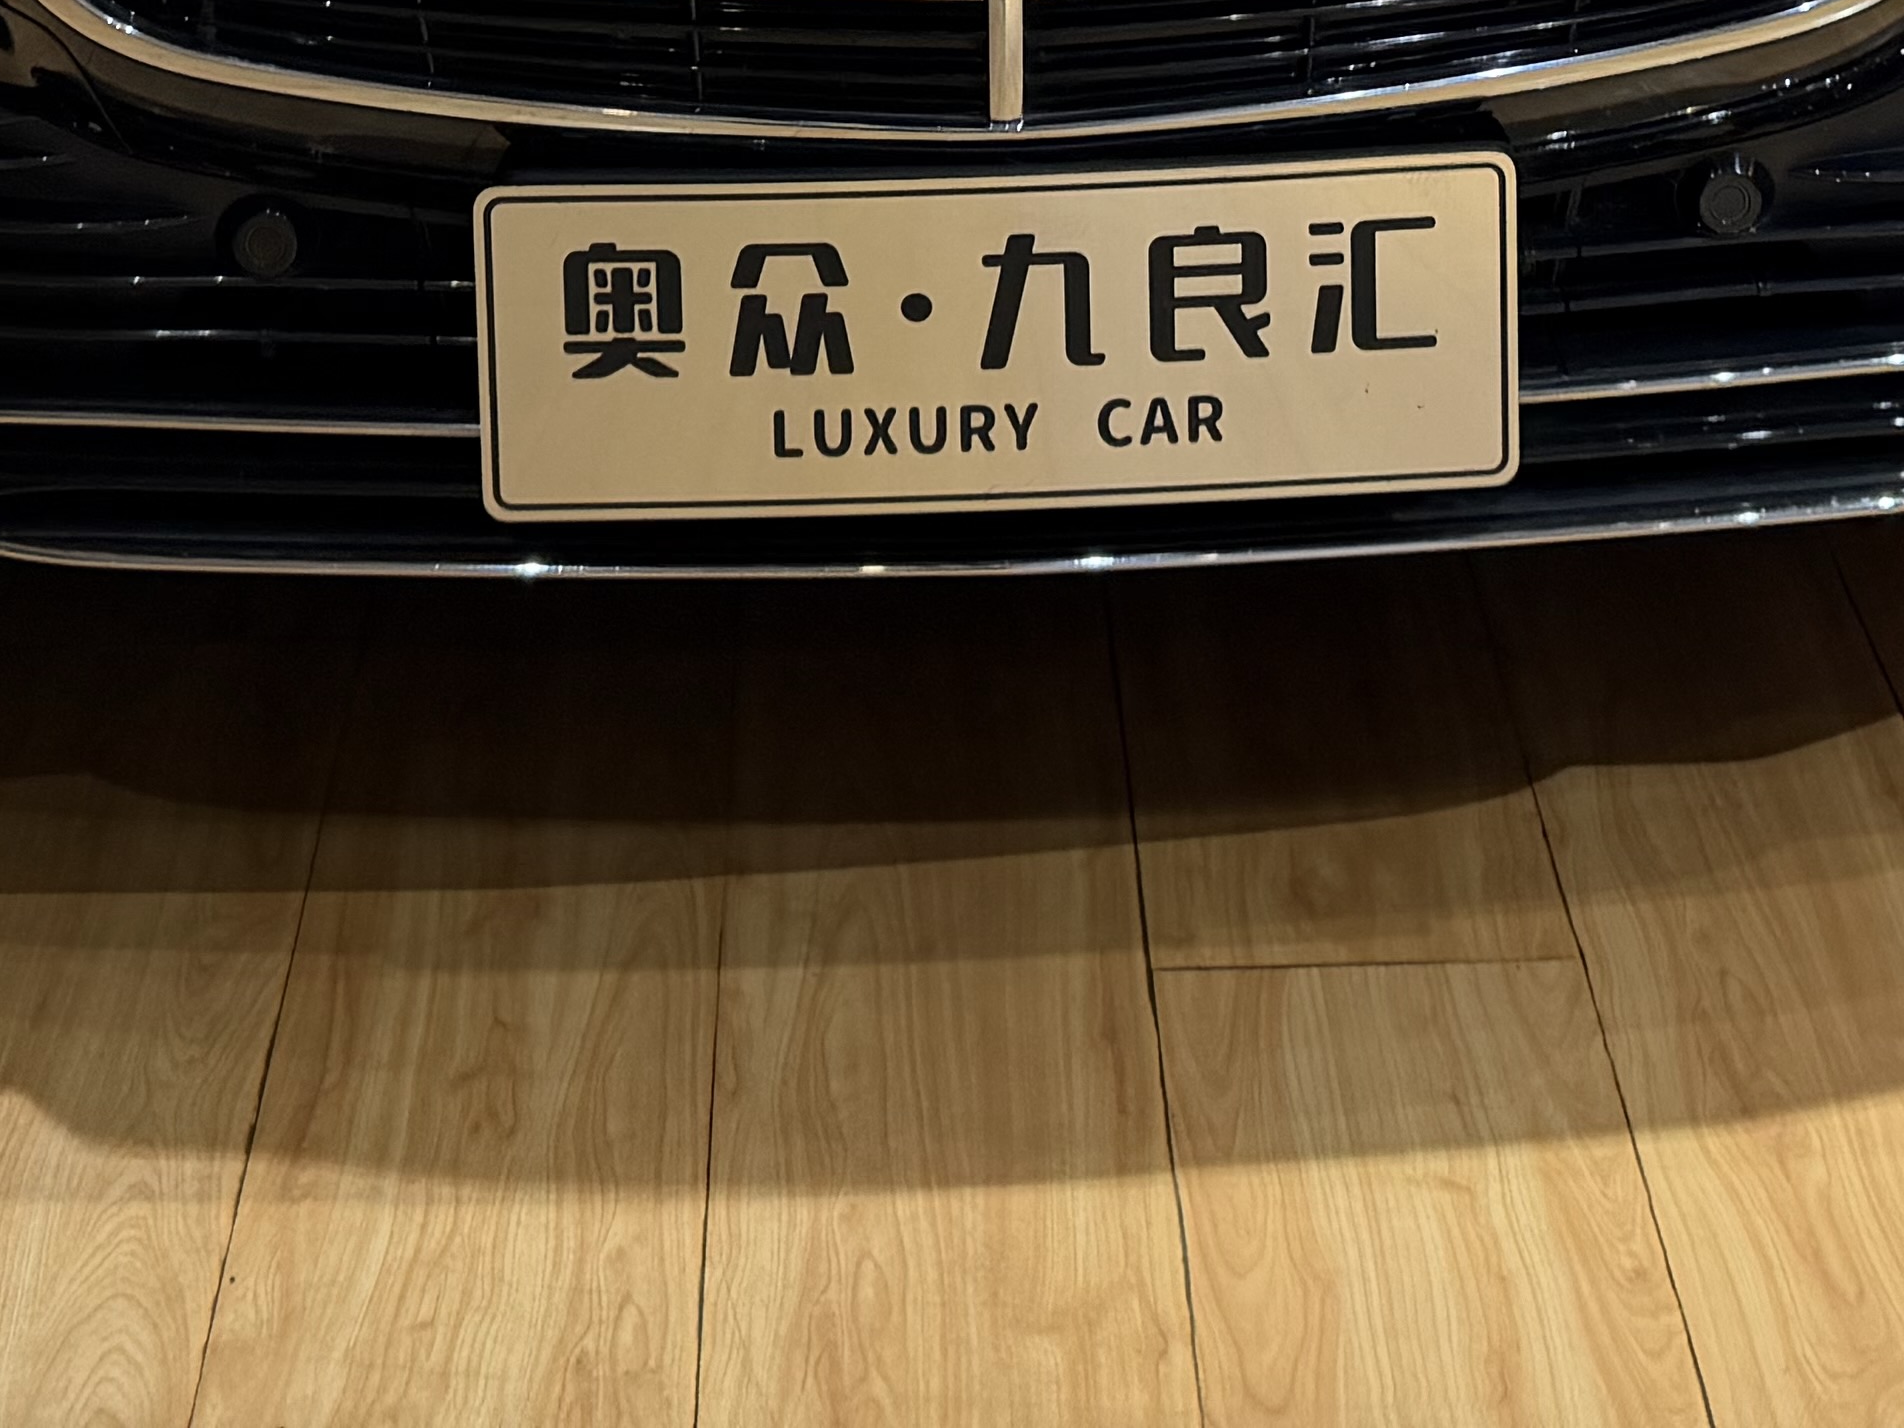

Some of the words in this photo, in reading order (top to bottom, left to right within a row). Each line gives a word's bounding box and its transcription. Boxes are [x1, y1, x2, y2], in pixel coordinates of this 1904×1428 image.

[561, 215, 1438, 379] 奥众·九良汇
[772, 402, 1040, 459] LUXURY
[1096, 393, 1225, 448] CAR
